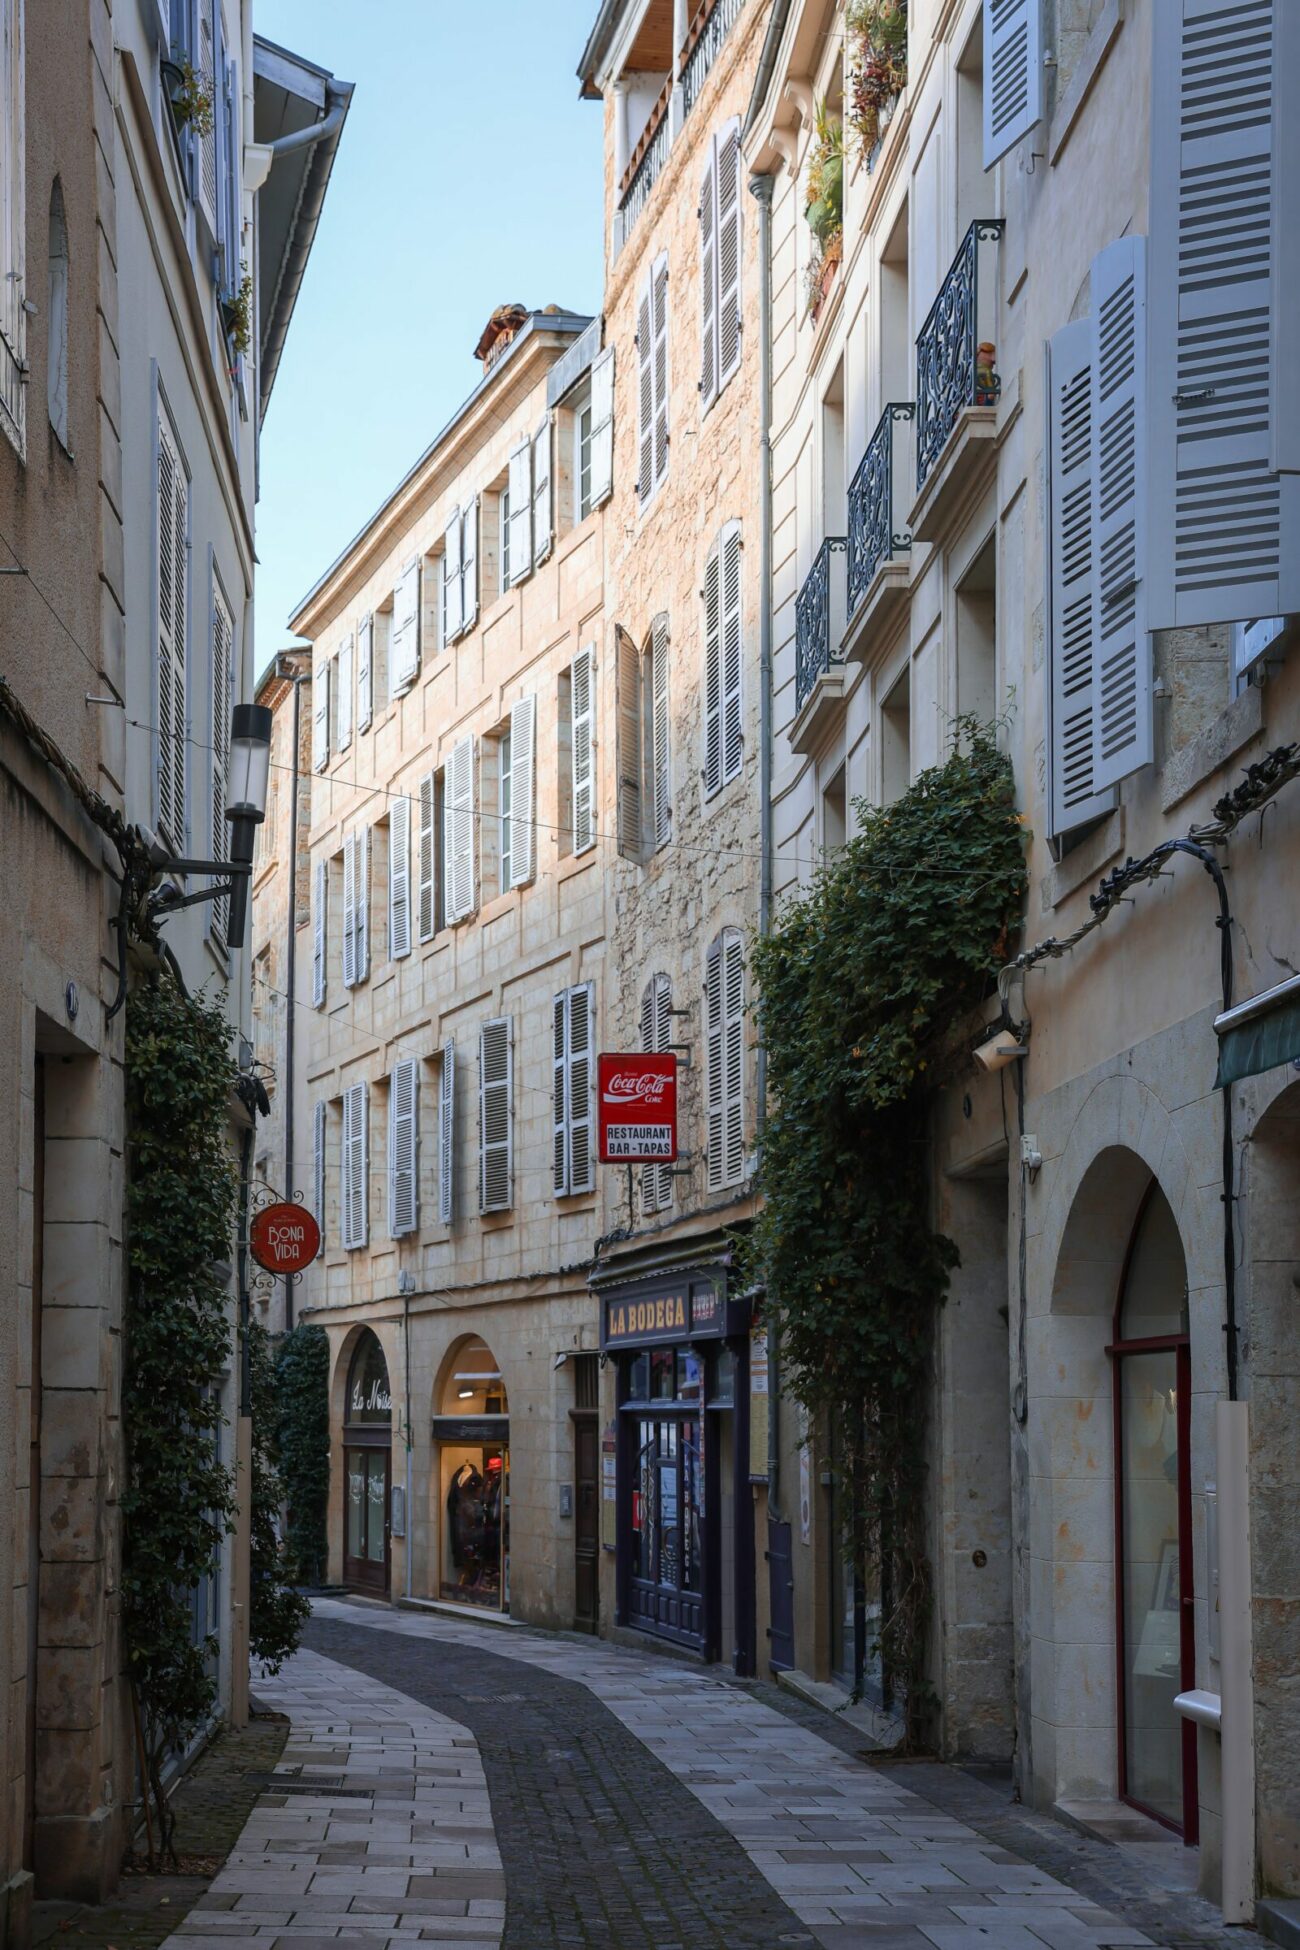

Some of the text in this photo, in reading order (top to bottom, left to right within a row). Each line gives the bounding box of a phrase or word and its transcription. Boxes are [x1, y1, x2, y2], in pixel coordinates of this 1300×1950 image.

[608, 1073, 666, 1094] Coca-Cola
[608, 1127, 672, 1139] RESTAURANT
[609, 1143, 630, 1154] BAR
[638, 1143, 670, 1154] TAPAS
[268, 1226, 304, 1245] BONA
[274, 1243, 299, 1262] VIDA
[609, 1307, 626, 1336] LA
[628, 1295, 685, 1333] BODEGA
